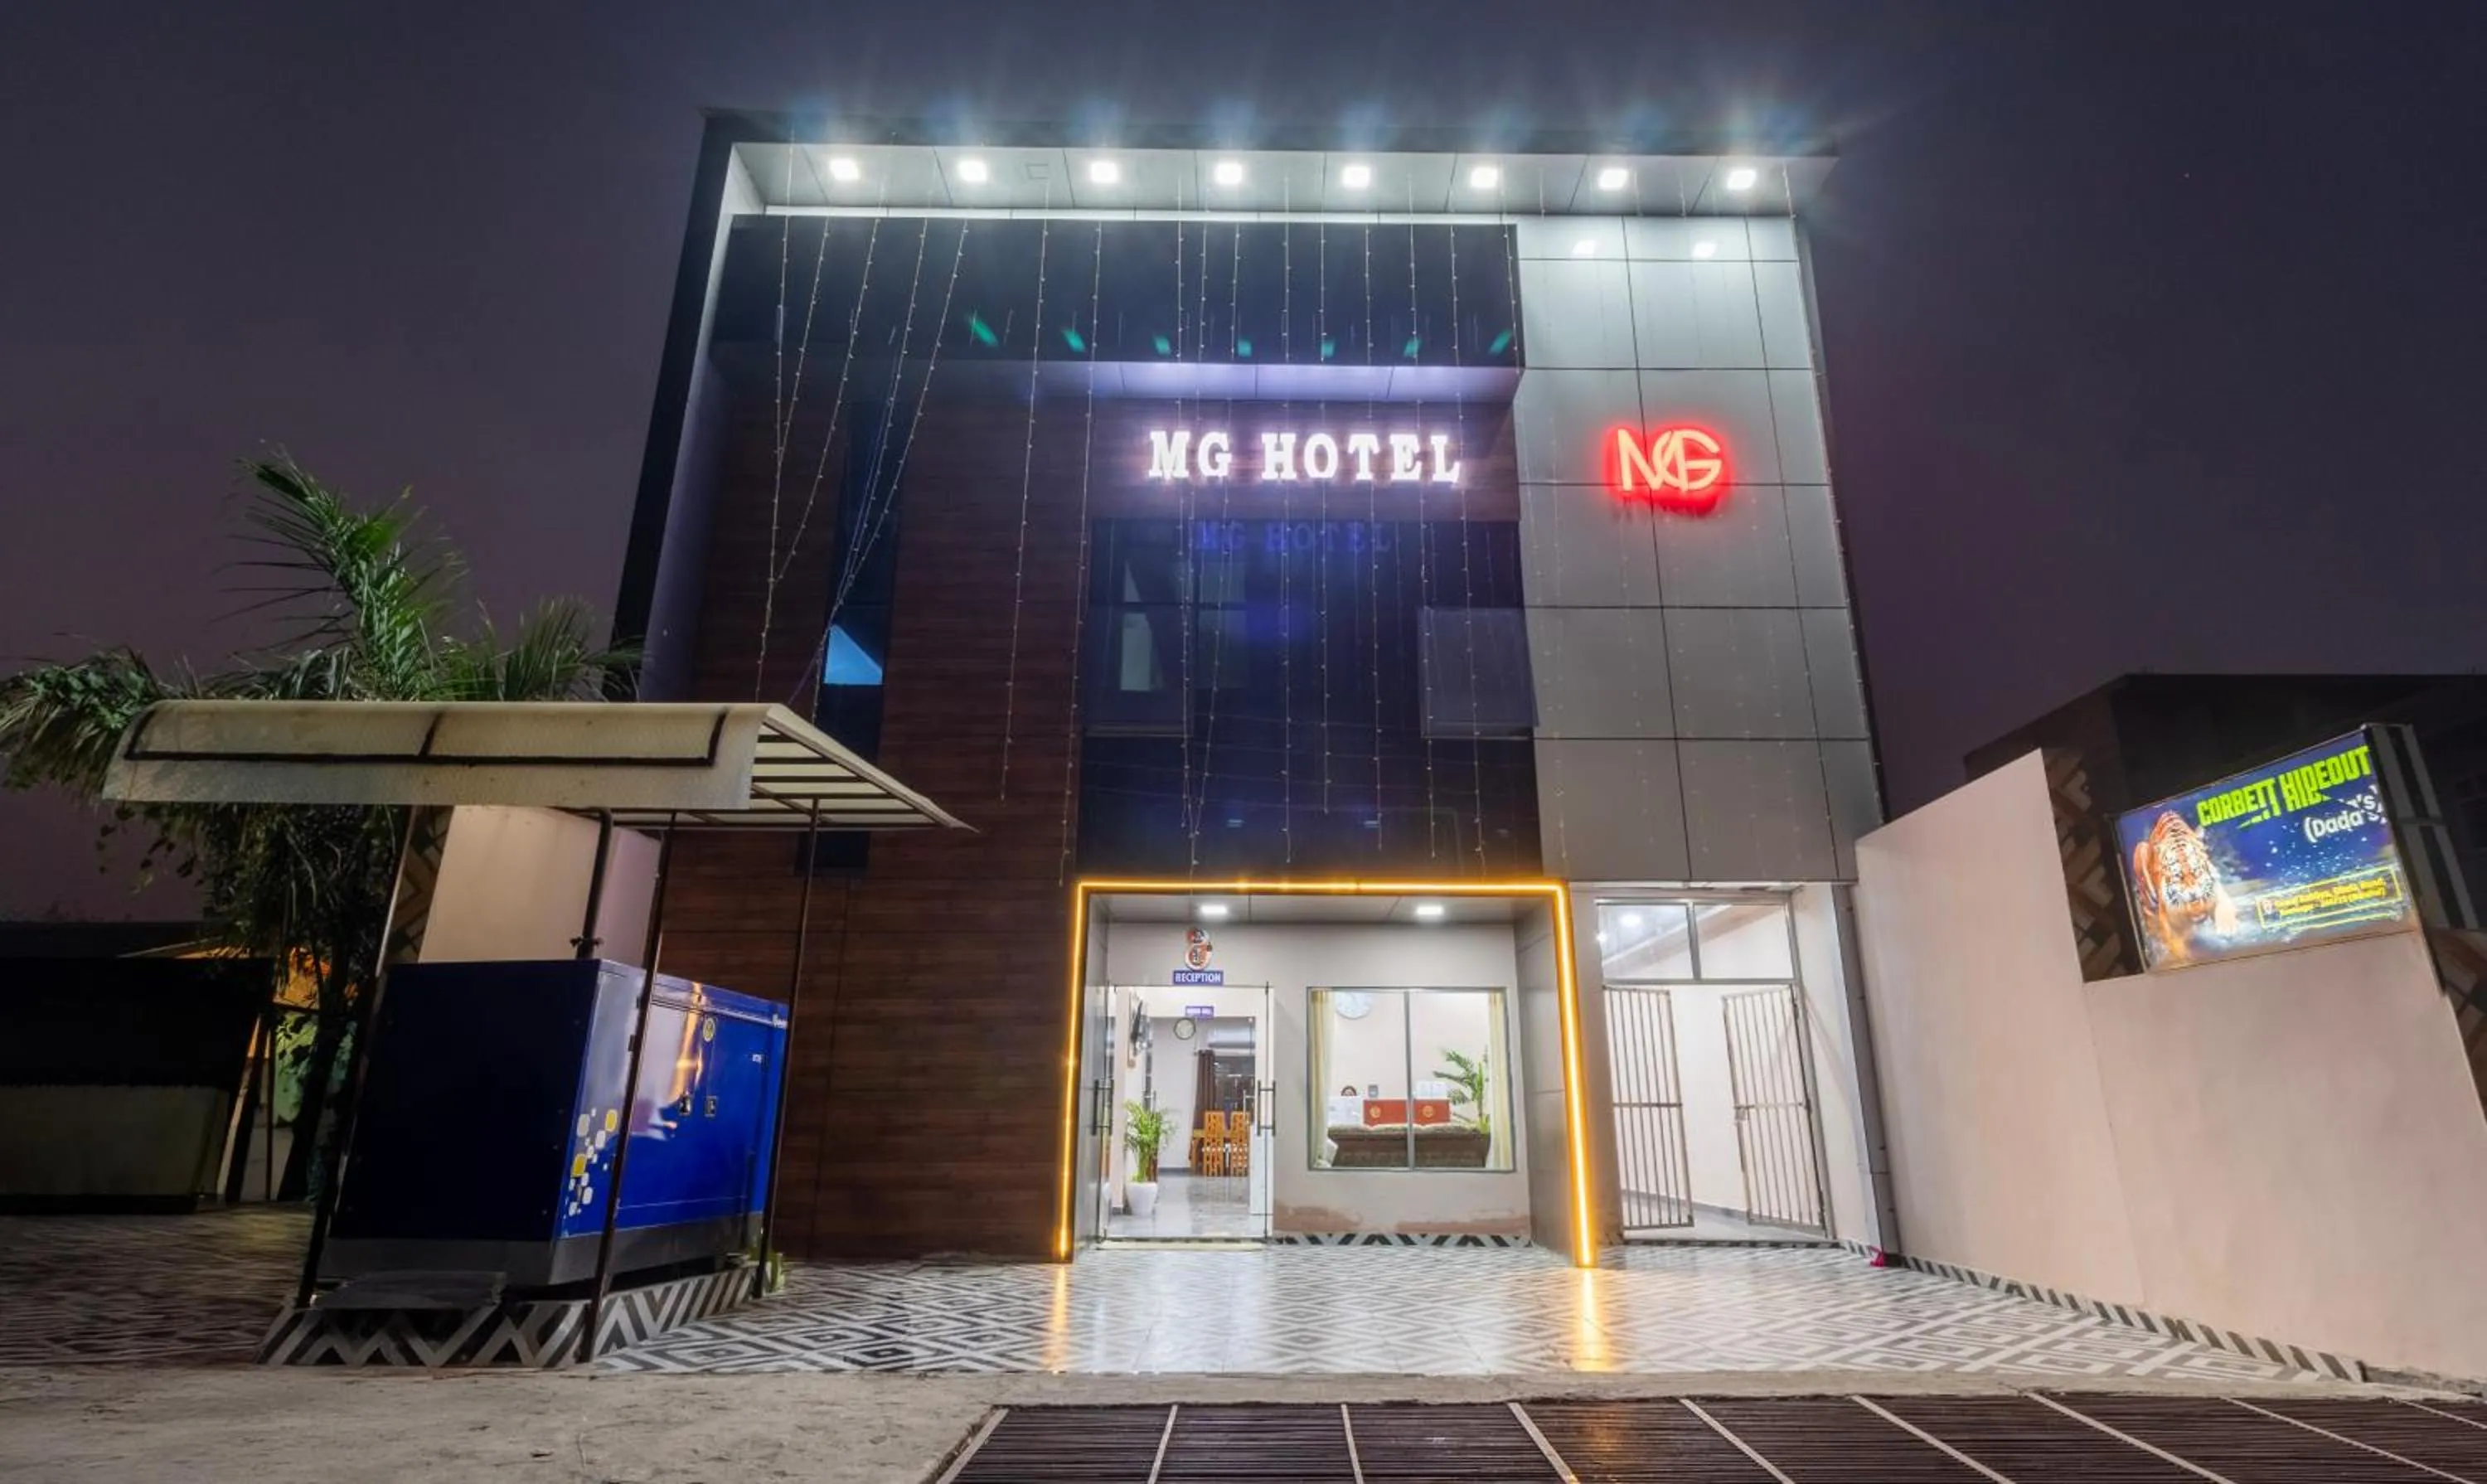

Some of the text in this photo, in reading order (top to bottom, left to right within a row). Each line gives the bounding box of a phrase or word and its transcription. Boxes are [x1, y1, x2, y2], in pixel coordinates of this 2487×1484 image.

[1148, 430, 1461, 483] MG HOTEL
[1617, 429, 1723, 492] MG
[2196, 744, 2372, 828] CORBETT HIDEOUT
[1175, 972, 1221, 982] RECEPTION
